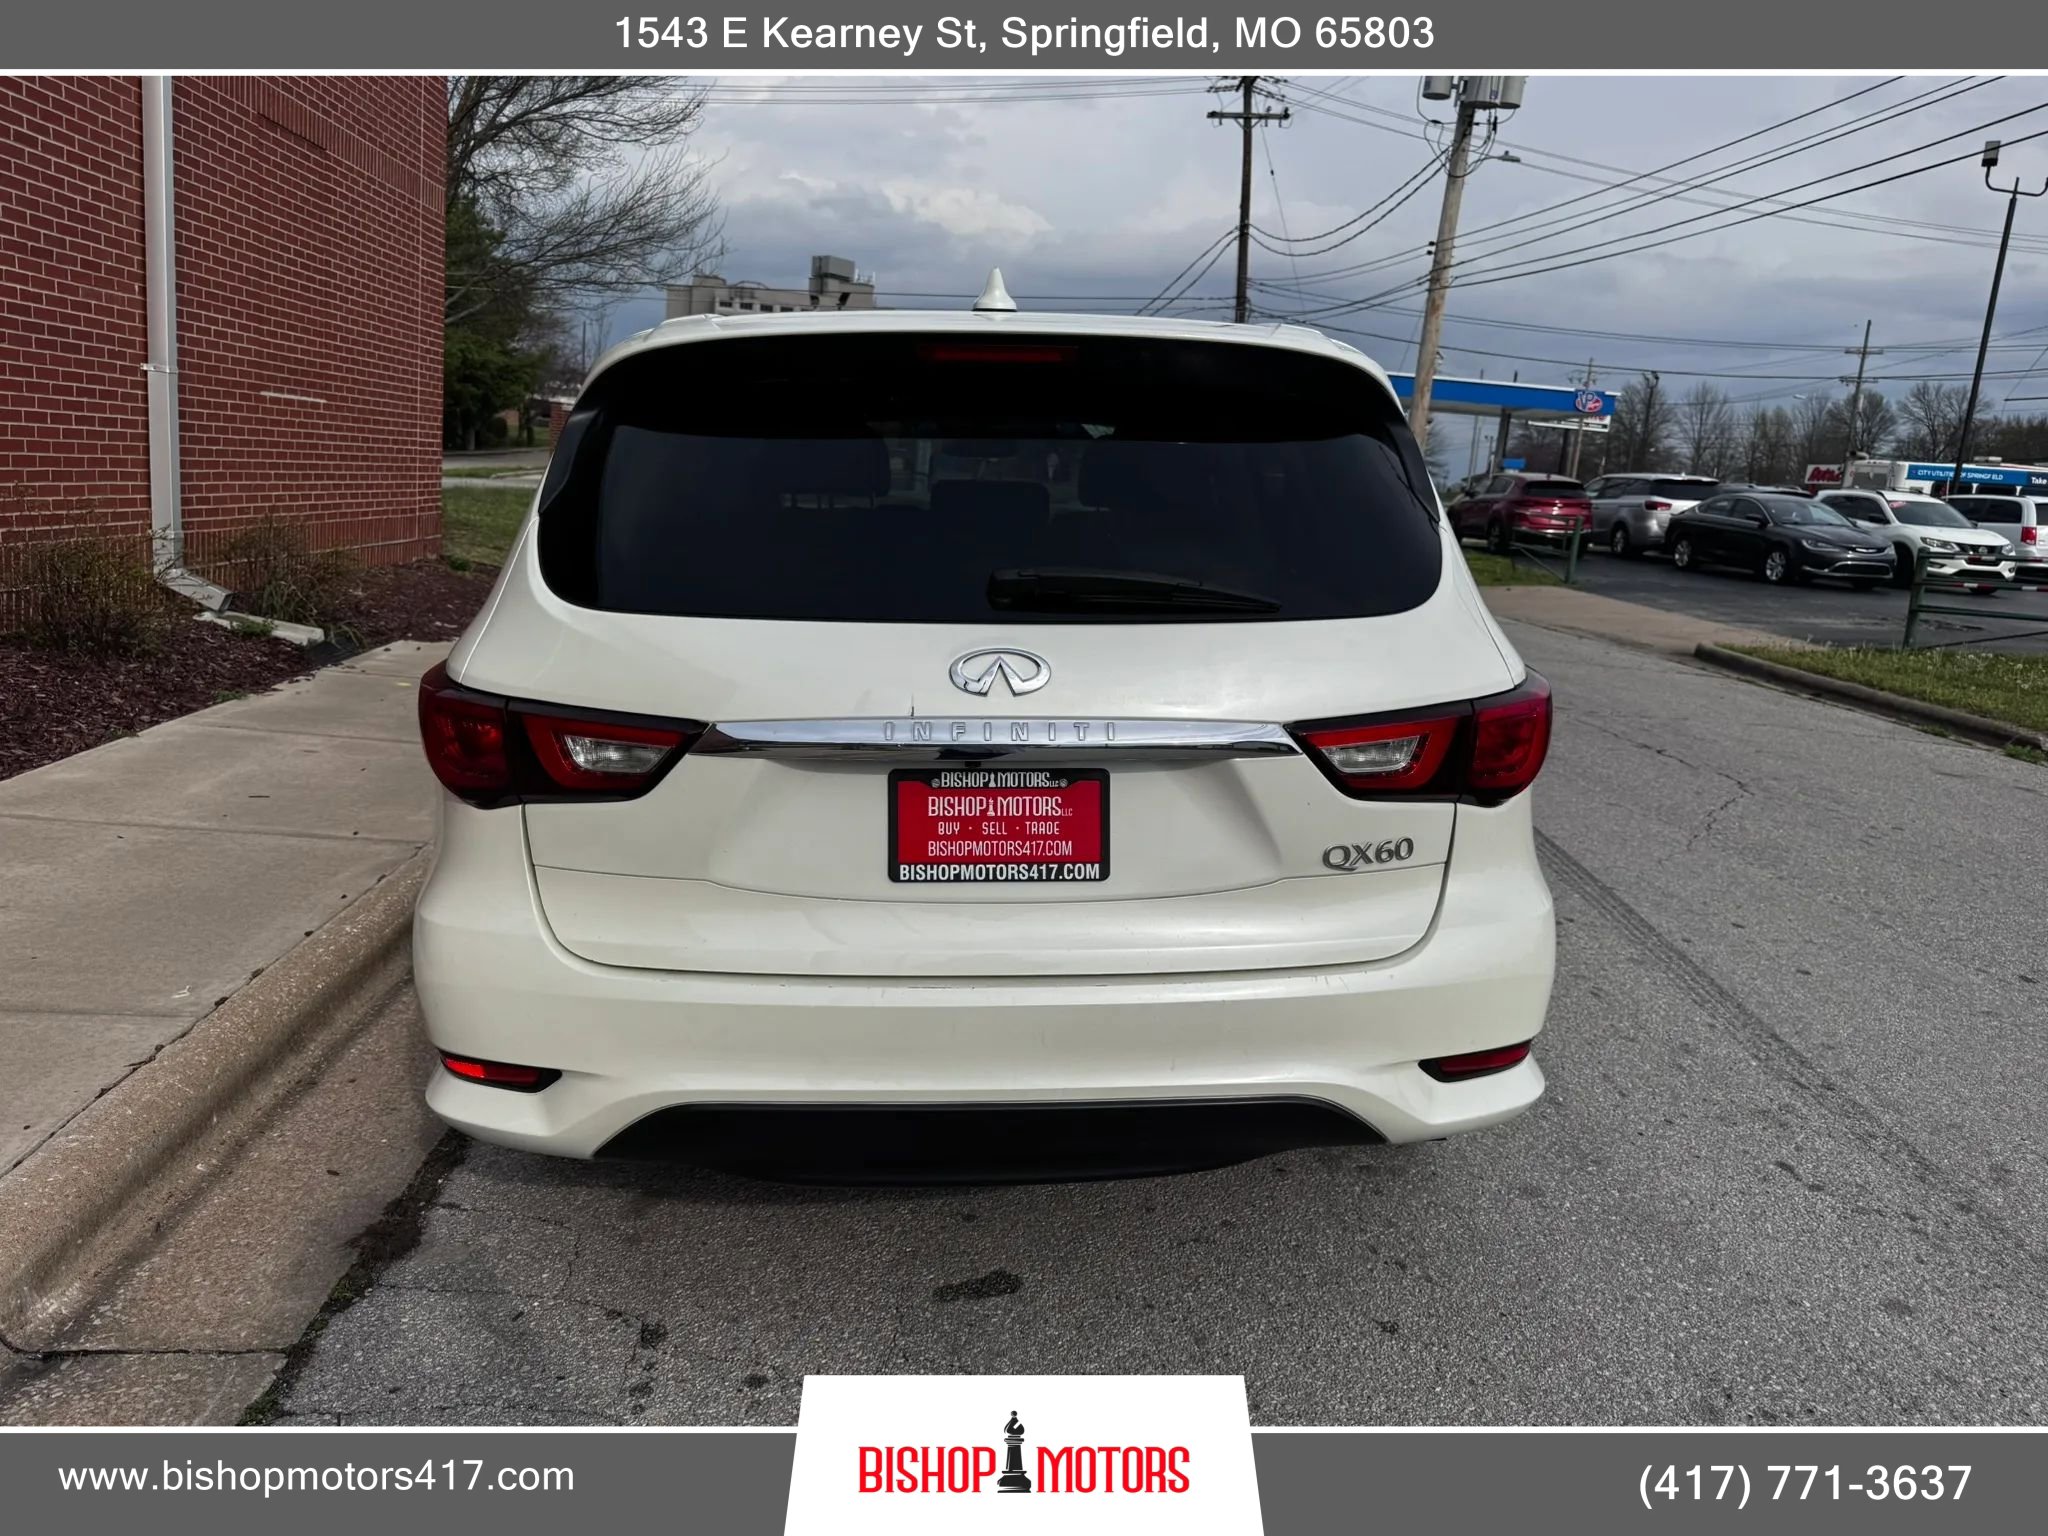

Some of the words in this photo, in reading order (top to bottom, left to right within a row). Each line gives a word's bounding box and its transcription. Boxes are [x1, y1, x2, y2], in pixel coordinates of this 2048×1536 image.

[2031, 476, 2048, 485] Take
[884, 721, 1116, 742] INFINITI
[941, 772, 990, 788] BISHOP
[997, 772, 1050, 788] MOTORS
[928, 796, 987, 817] BISHOP
[997, 796, 1062, 817] MOTORS
[938, 821, 960, 835] BUY
[982, 821, 1008, 835] SELL
[1025, 821, 1060, 835] TRADE
[928, 840, 1073, 857] BISHOPMOTORS417.COM
[1322, 837, 1415, 872] QX60
[900, 864, 1100, 881] BISHOPMOTORS417.COM
